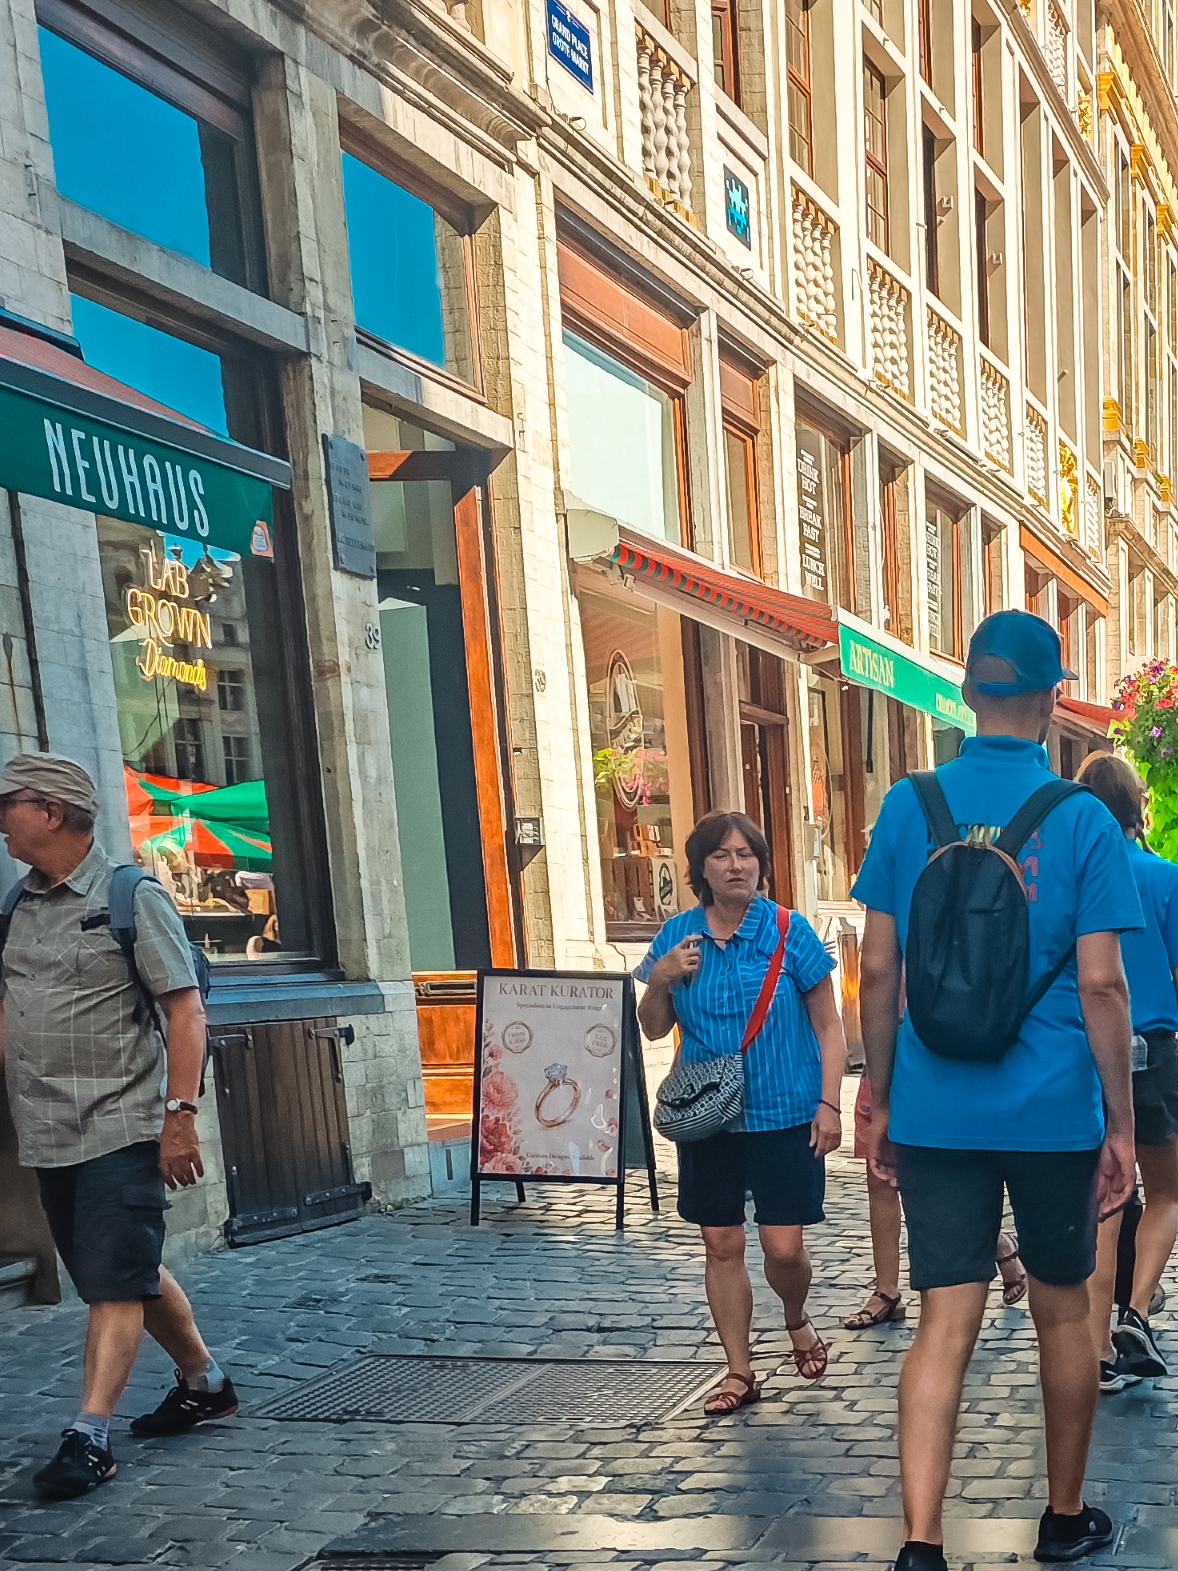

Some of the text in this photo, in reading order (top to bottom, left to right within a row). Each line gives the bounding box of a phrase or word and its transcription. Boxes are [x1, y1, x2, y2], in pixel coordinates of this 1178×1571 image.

[551, 14, 589, 60] GRAND PLACE
[570, 48, 590, 76] MARKT
[43, 418, 209, 537] NEUHAUS
[798, 505, 822, 529] BREAK
[802, 522, 820, 543] FAST
[139, 539, 190, 599] LAB
[802, 553, 825, 577] LUNCH
[804, 570, 825, 591] WELL
[126, 588, 213, 648] GROWN
[364, 622, 380, 650] 39
[136, 639, 208, 691] Diamonds
[849, 639, 894, 689] ARTISAN
[499, 983, 614, 999] KARAT KURATOR
